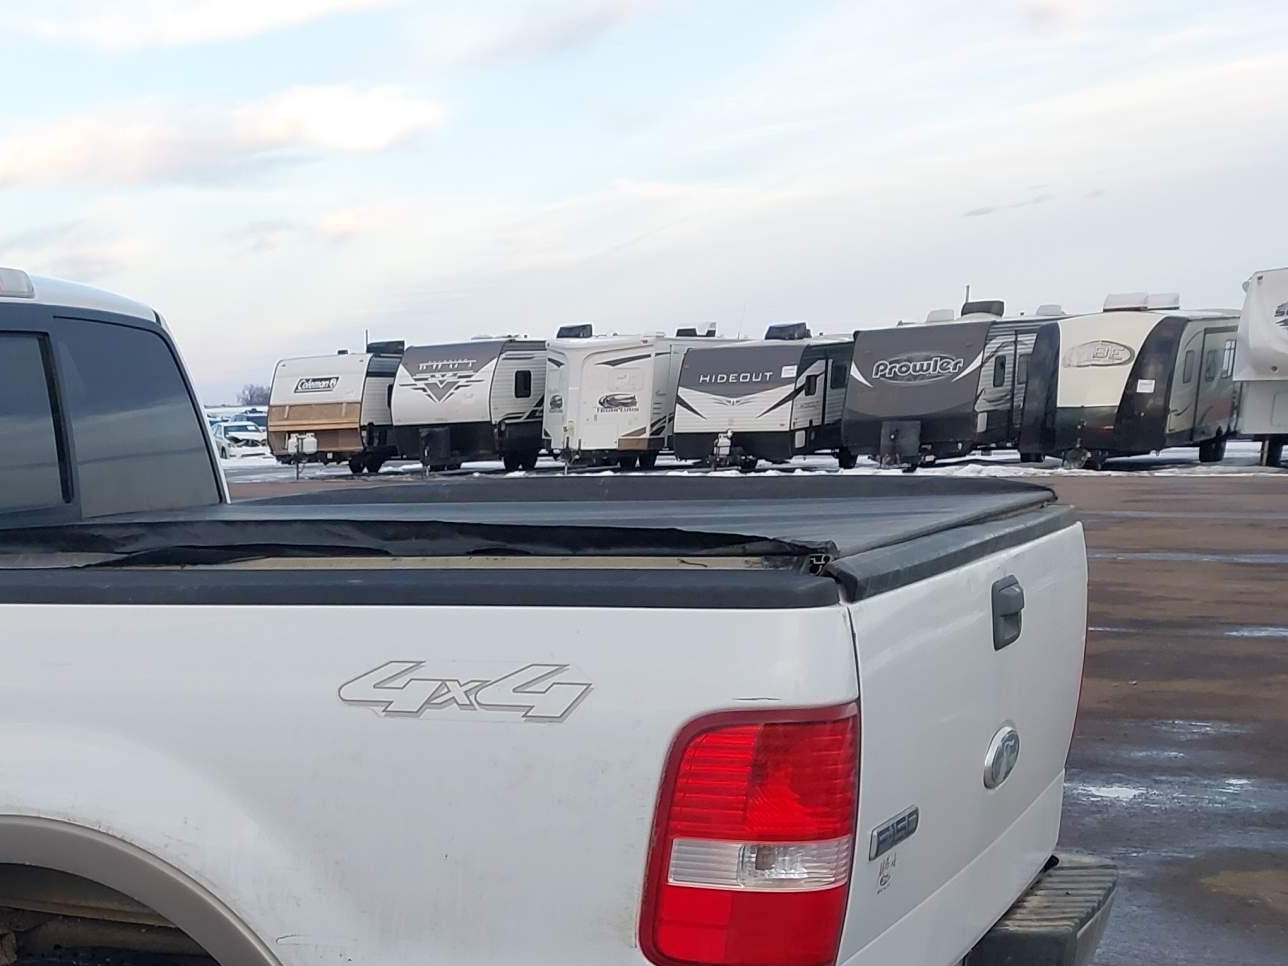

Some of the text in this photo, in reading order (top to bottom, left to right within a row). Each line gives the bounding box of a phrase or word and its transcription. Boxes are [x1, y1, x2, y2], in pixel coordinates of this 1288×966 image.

[699, 372, 774, 384] HIDEOUT
[872, 357, 964, 378] Prowler
[338, 661, 593, 721] 4x4
